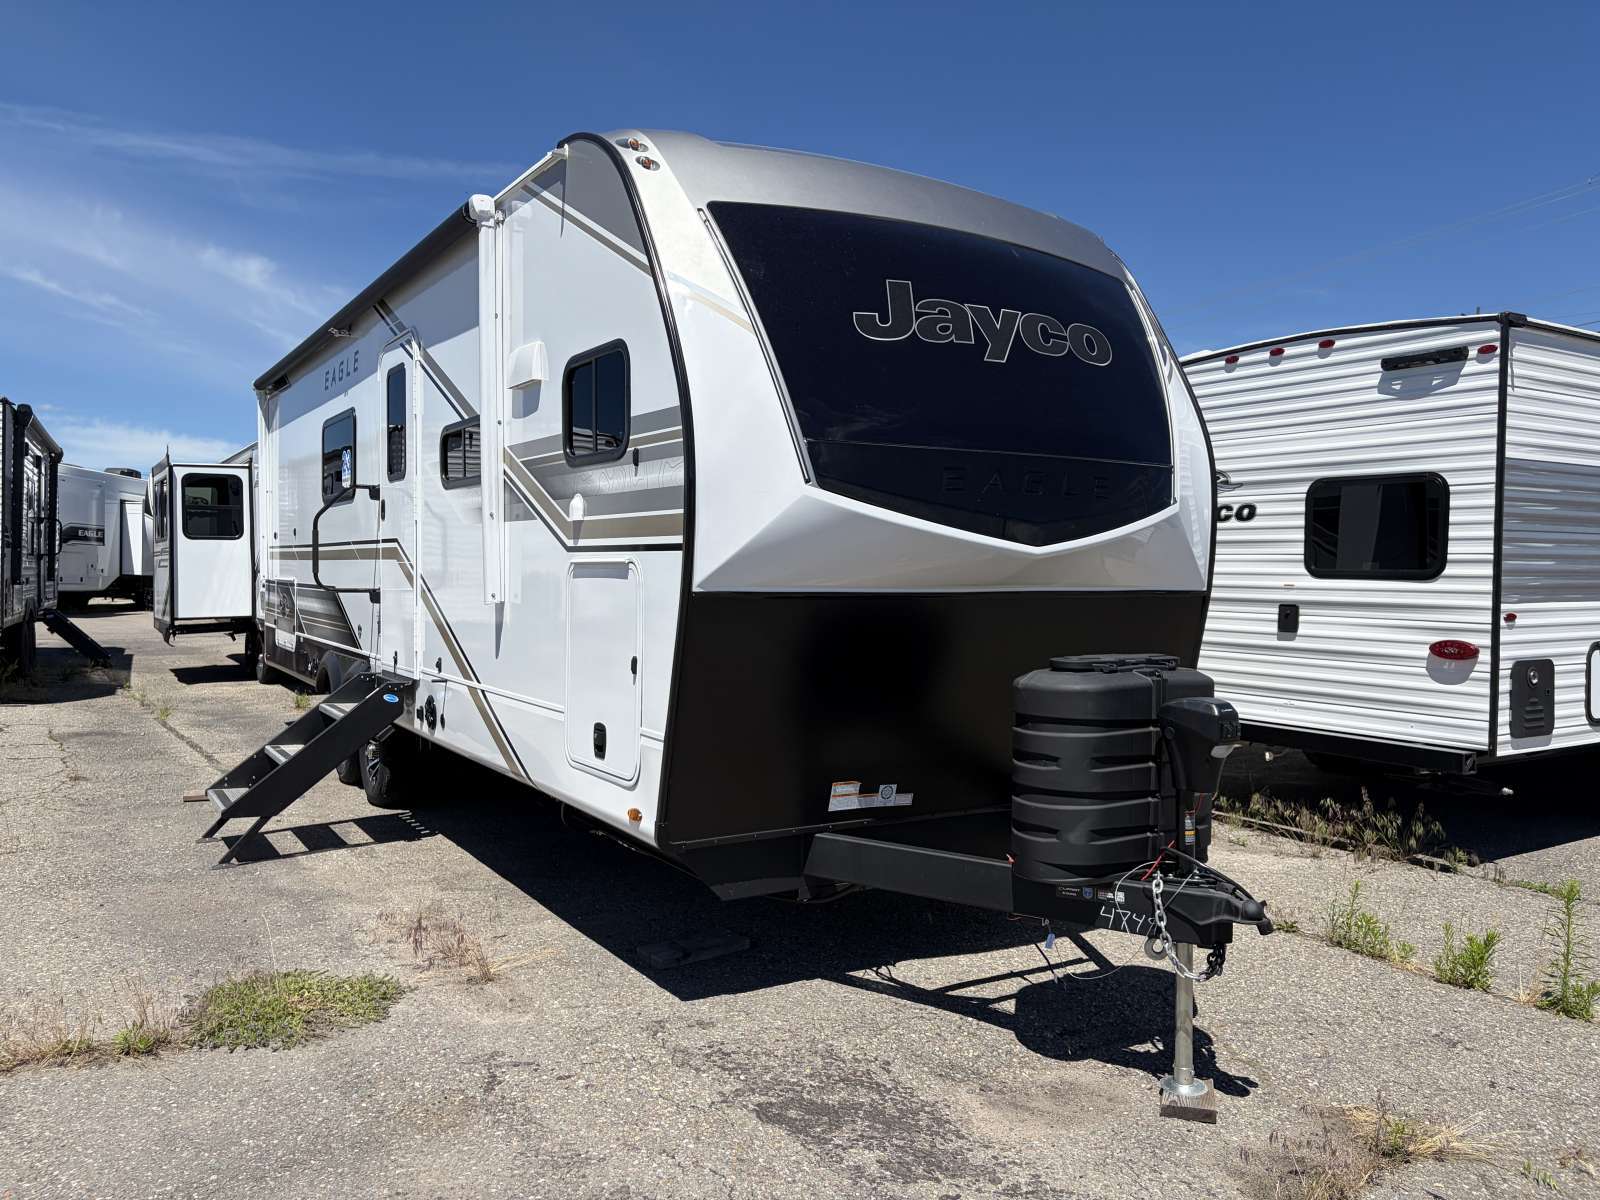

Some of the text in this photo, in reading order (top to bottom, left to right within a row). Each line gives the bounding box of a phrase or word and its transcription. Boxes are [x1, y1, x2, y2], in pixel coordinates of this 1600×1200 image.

[853, 279, 1112, 366] Jayco
[324, 350, 359, 391] EAGLE
[943, 466, 1110, 500] EAGLE
[78, 529, 104, 537] EAGLE
